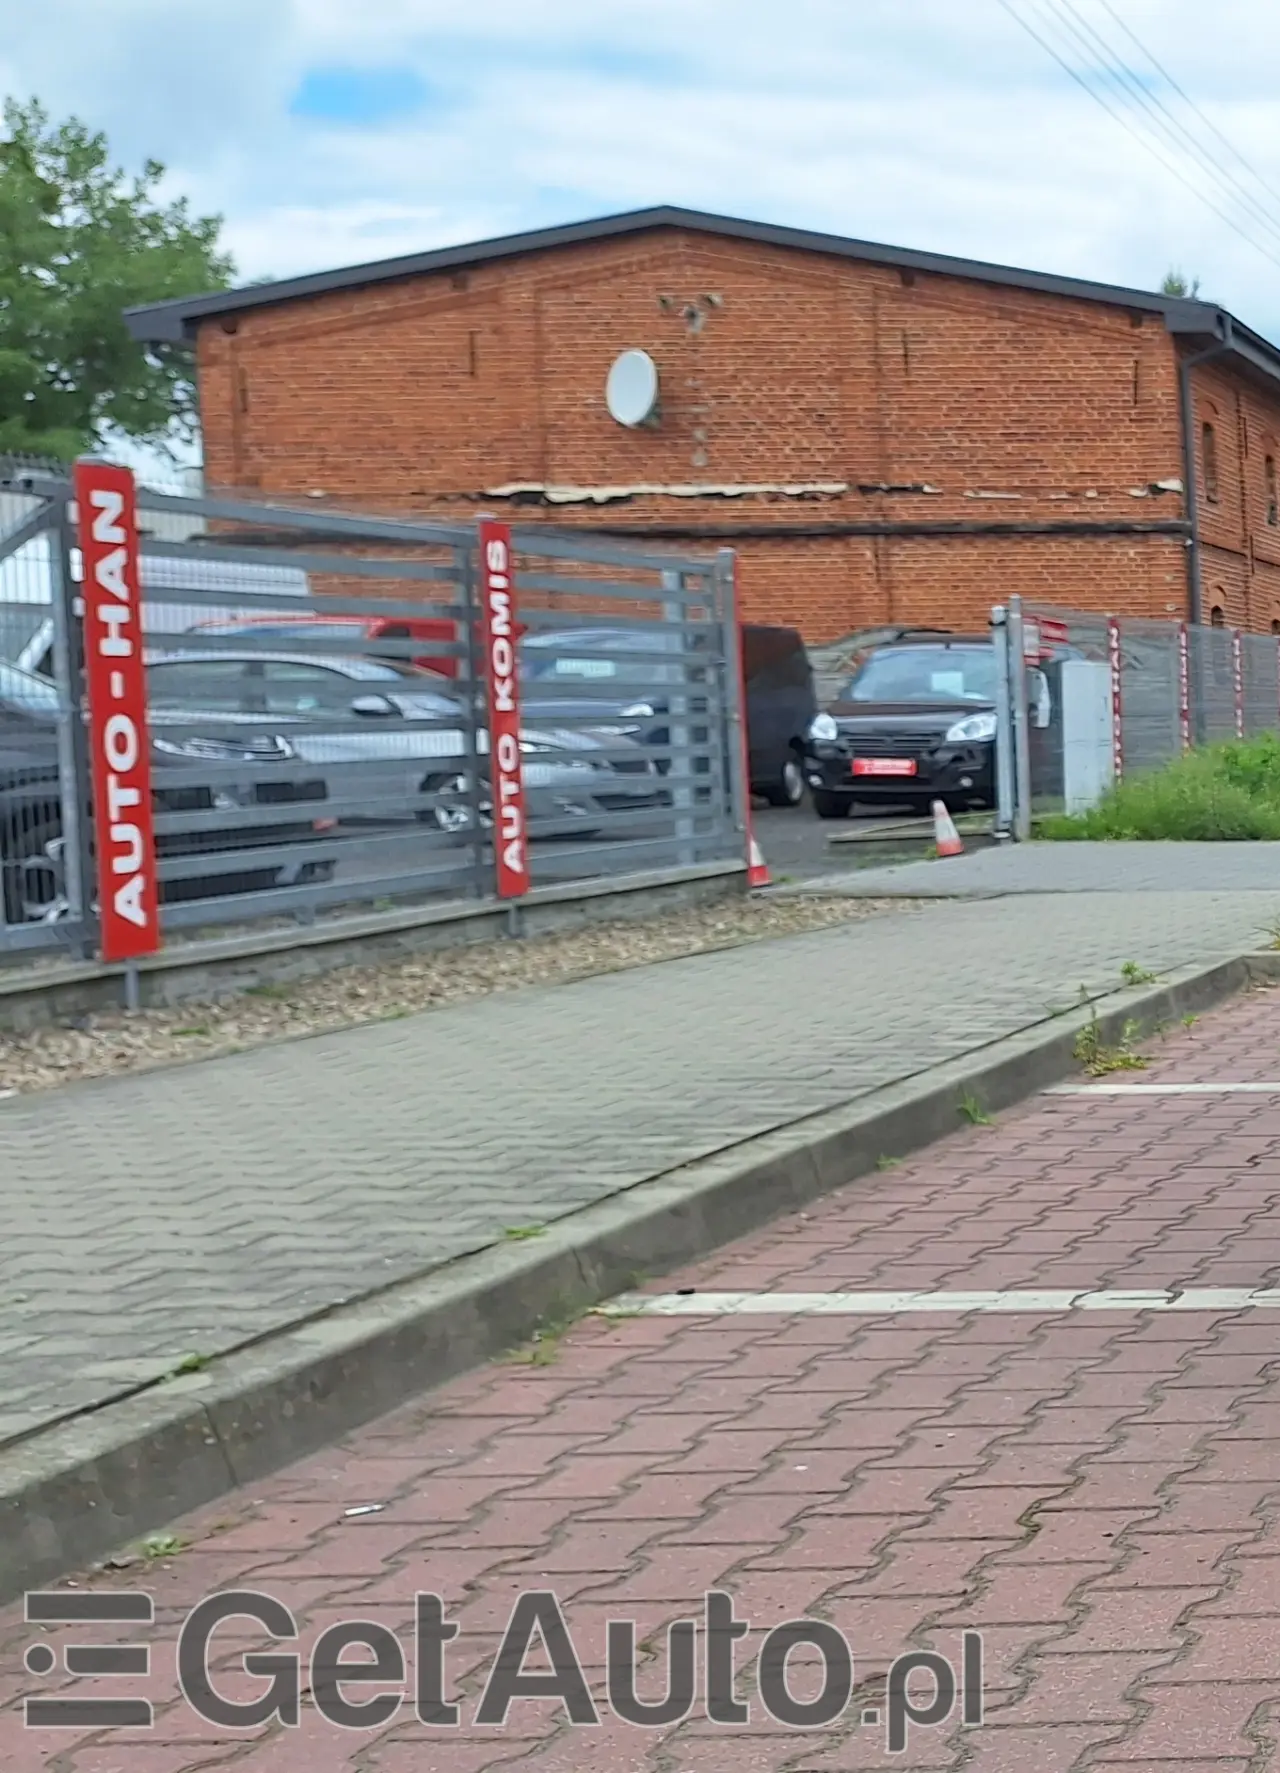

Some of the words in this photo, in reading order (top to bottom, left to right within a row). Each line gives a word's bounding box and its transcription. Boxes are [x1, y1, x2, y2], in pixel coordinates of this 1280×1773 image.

[89, 489, 133, 657] HAN
[486, 540, 515, 711] KOMIS
[104, 713, 147, 927] AUTO
[499, 733, 525, 873] AUTO
